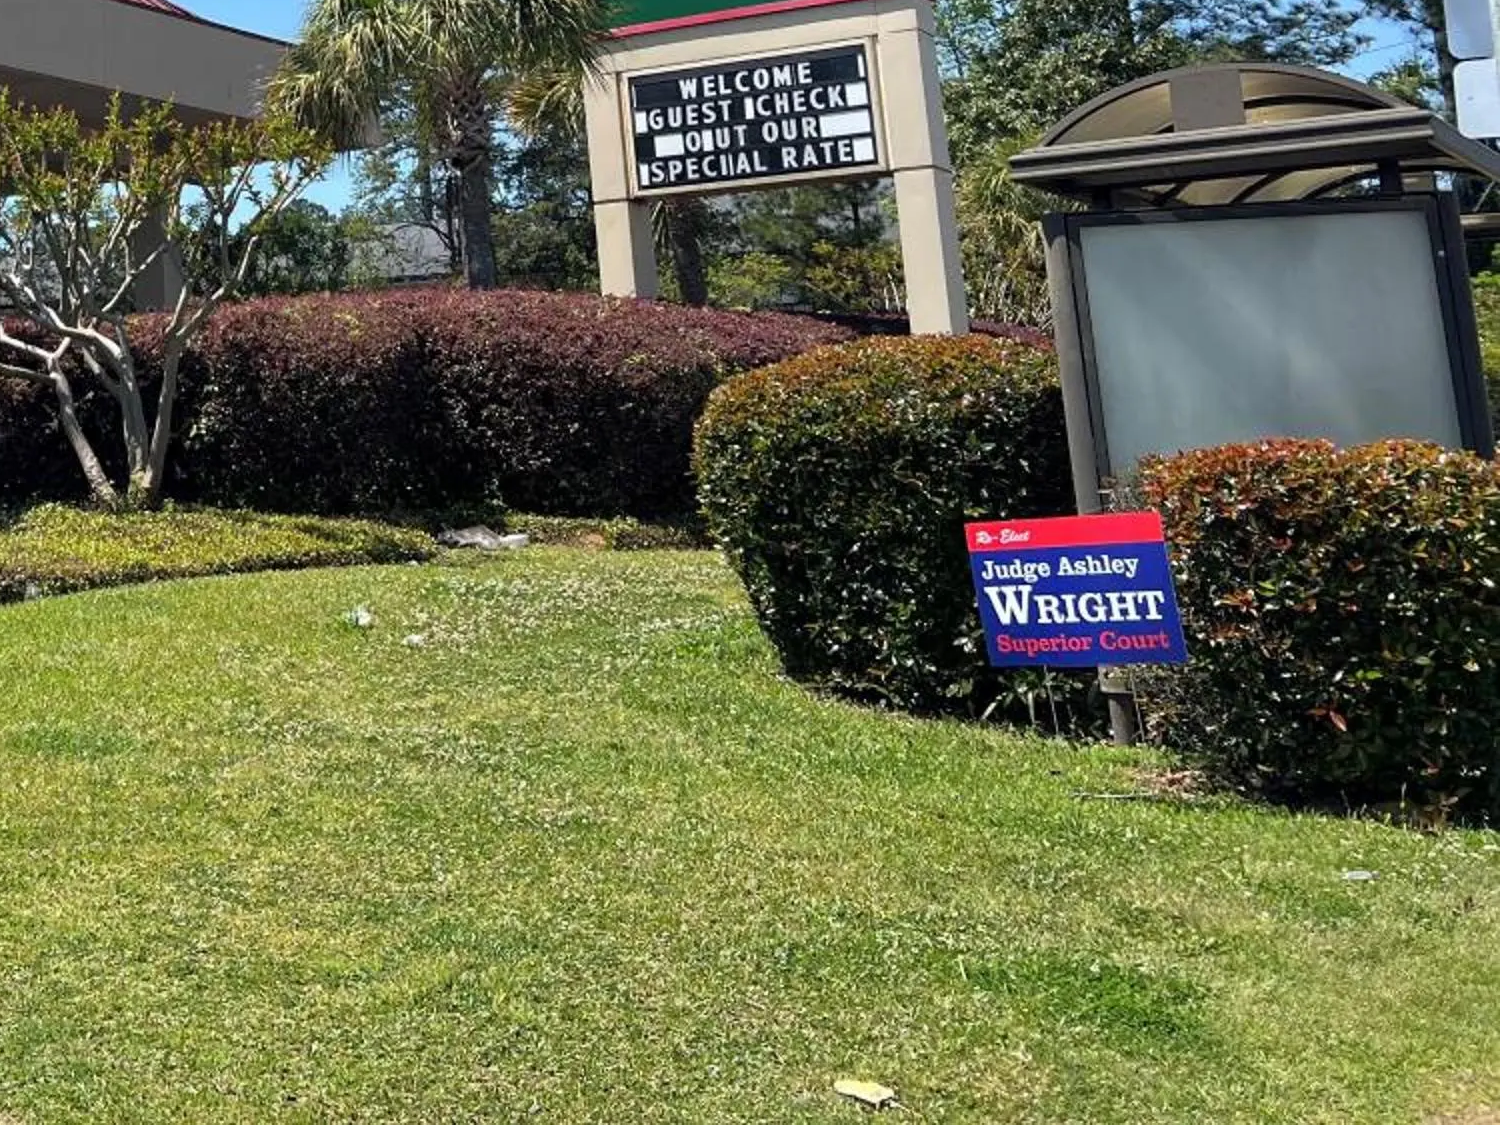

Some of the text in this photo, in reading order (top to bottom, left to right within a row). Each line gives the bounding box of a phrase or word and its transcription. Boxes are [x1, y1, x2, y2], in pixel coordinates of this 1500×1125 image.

[678, 62, 813, 101] WELCOME
[649, 83, 847, 131] GUEST CHECK
[685, 116, 819, 153] OUT OUR
[651, 138, 853, 184] SPECIAL RATE
[982, 554, 1139, 583] Judge Ashley
[984, 584, 1165, 626] WRIGHT
[997, 629, 1171, 658] Superior Court
